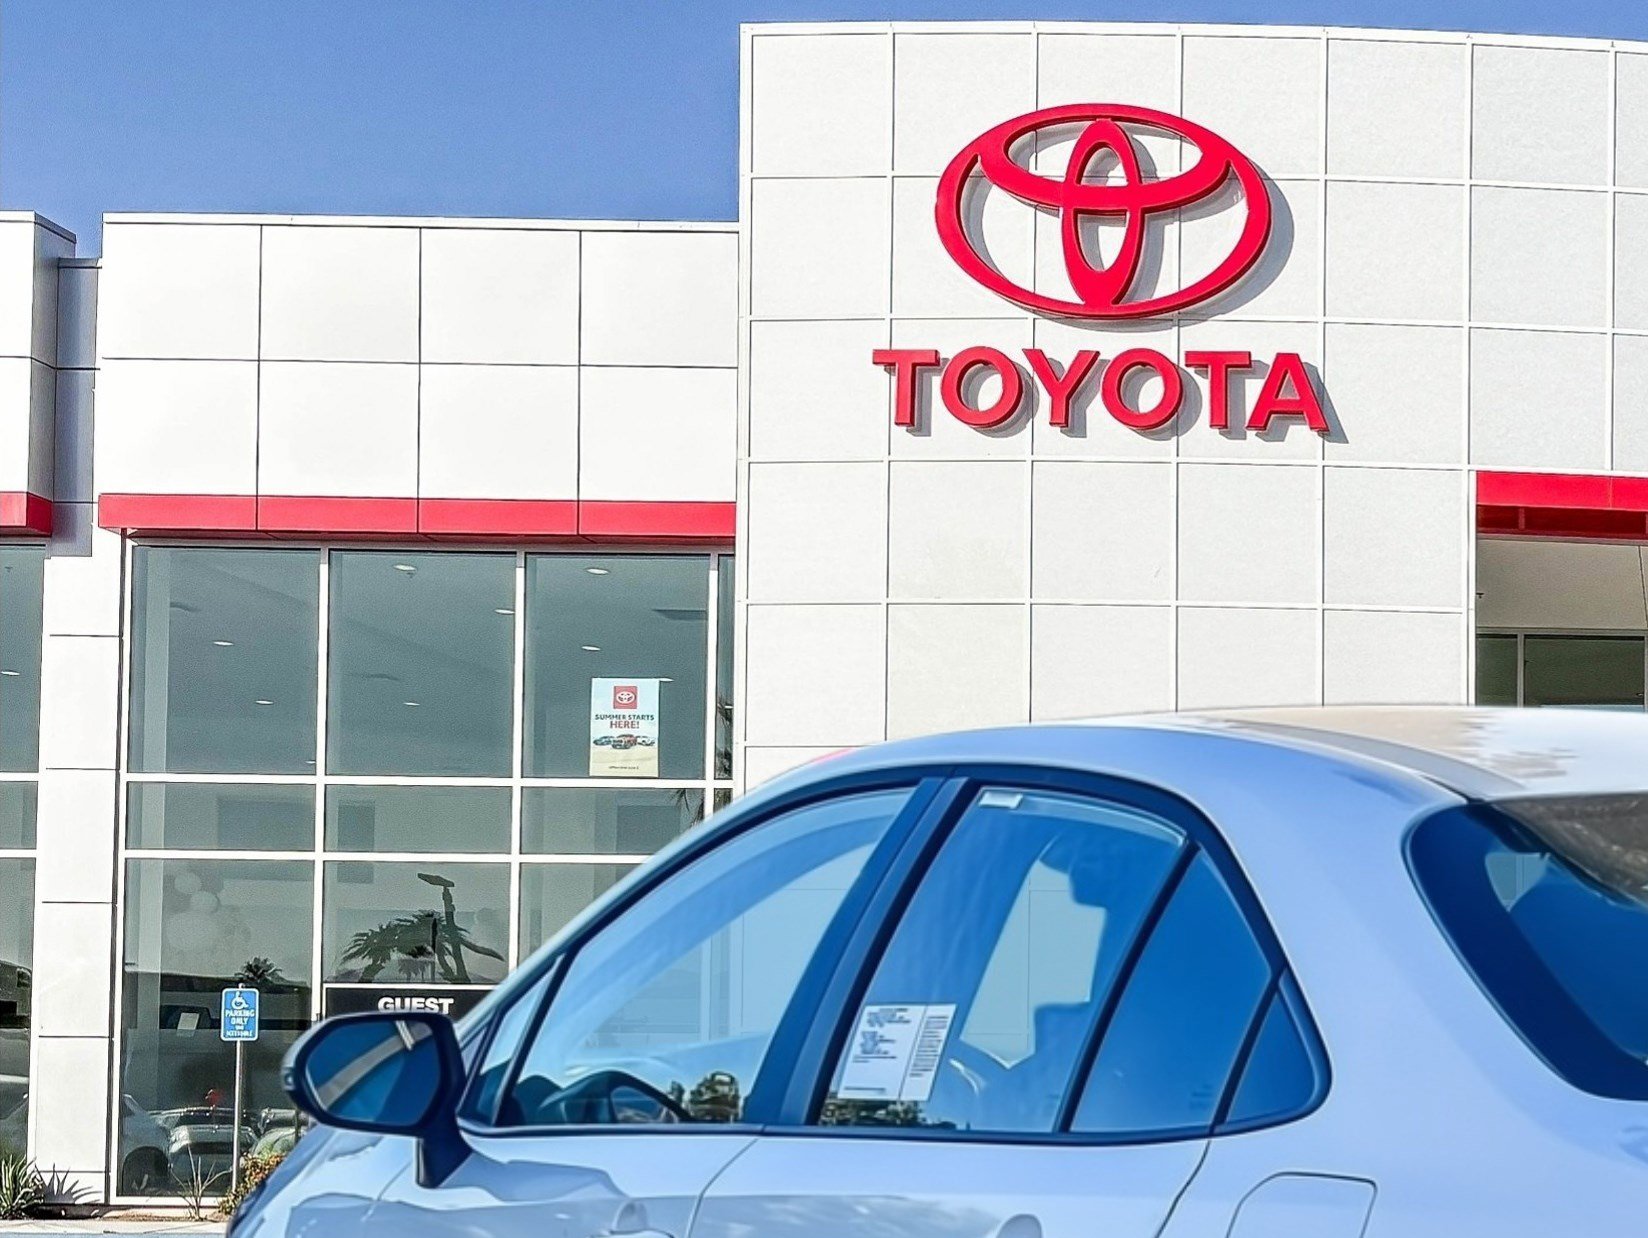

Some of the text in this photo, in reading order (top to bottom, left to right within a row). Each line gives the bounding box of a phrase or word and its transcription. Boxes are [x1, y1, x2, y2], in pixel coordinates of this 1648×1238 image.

[872, 346, 1330, 433] TOYOTA
[610, 720, 640, 729] HERE!
[378, 996, 454, 1014] GUEST
